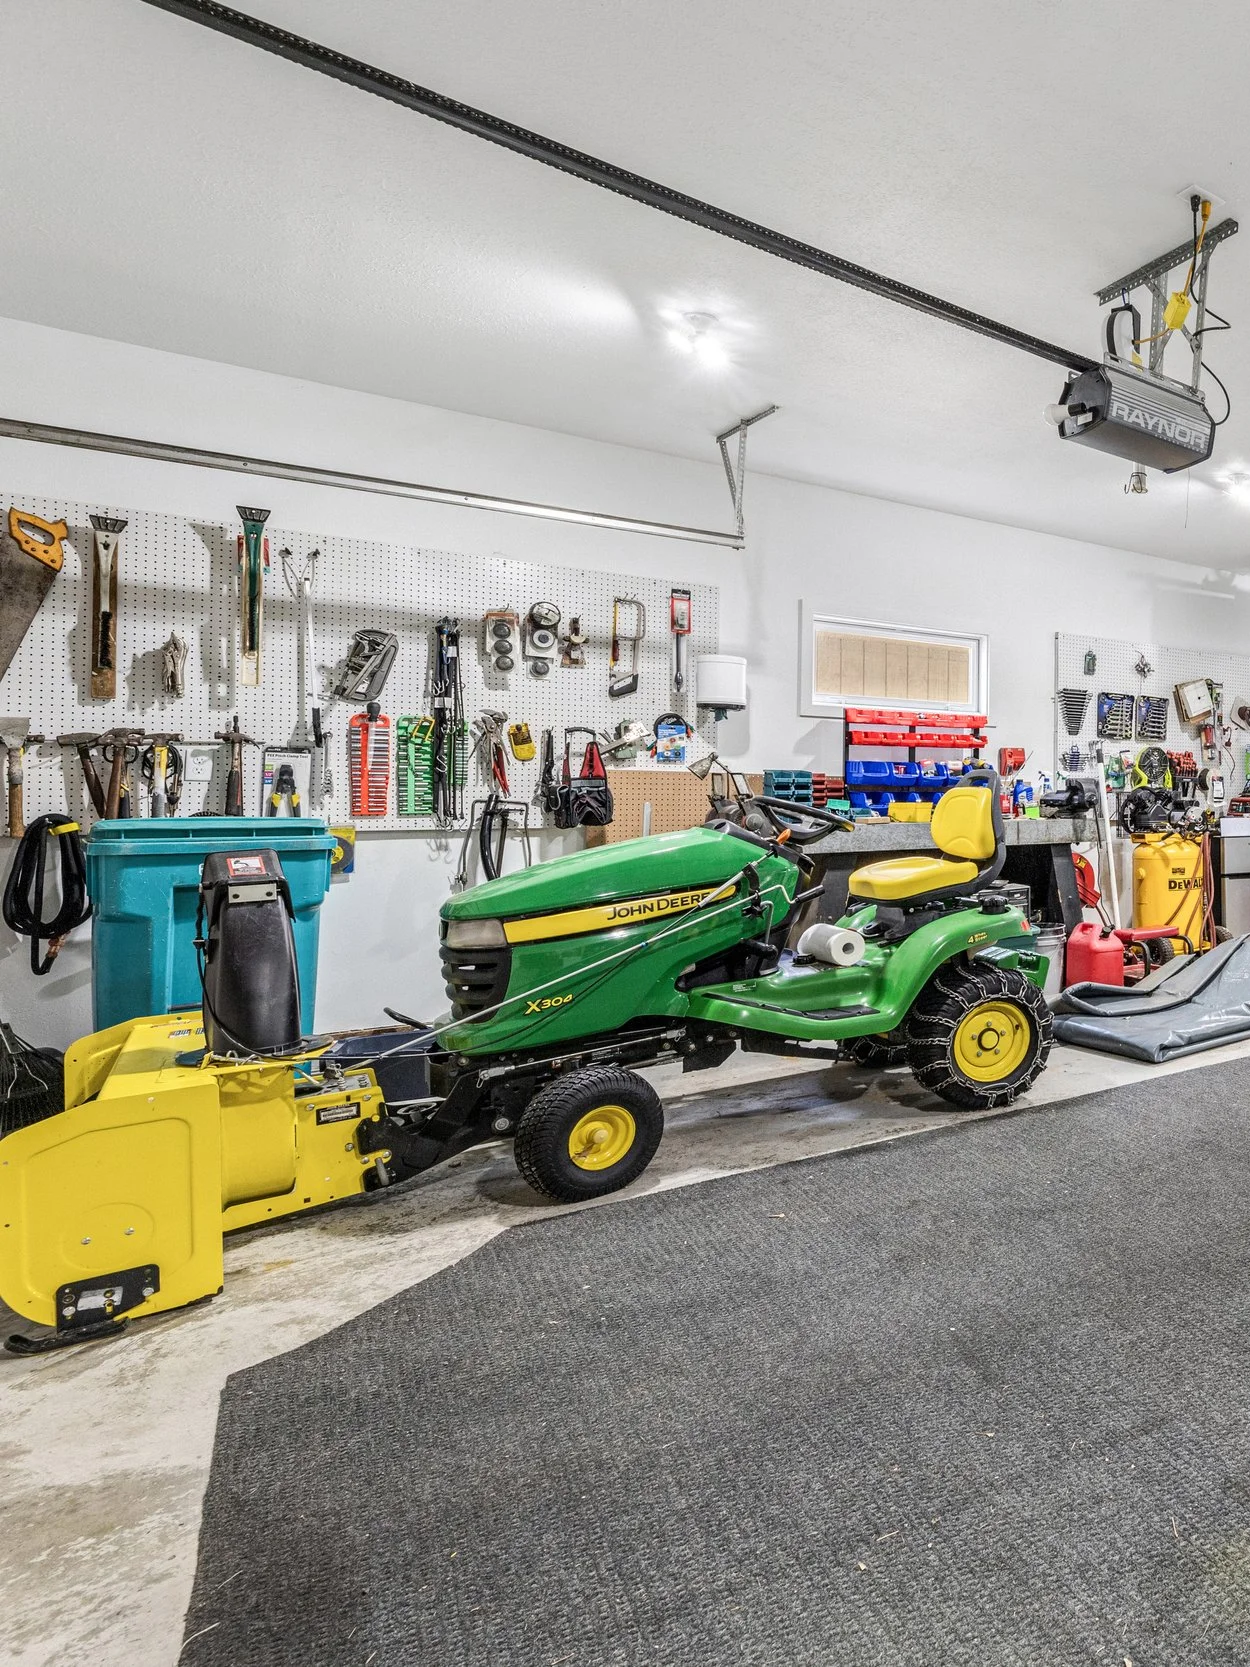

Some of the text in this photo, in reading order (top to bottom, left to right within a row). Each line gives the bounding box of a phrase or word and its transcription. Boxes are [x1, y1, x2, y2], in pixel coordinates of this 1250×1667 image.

[1111, 400, 1208, 449] RAYNOR
[607, 902, 654, 920] JOHN
[524, 994, 573, 1016] X304
